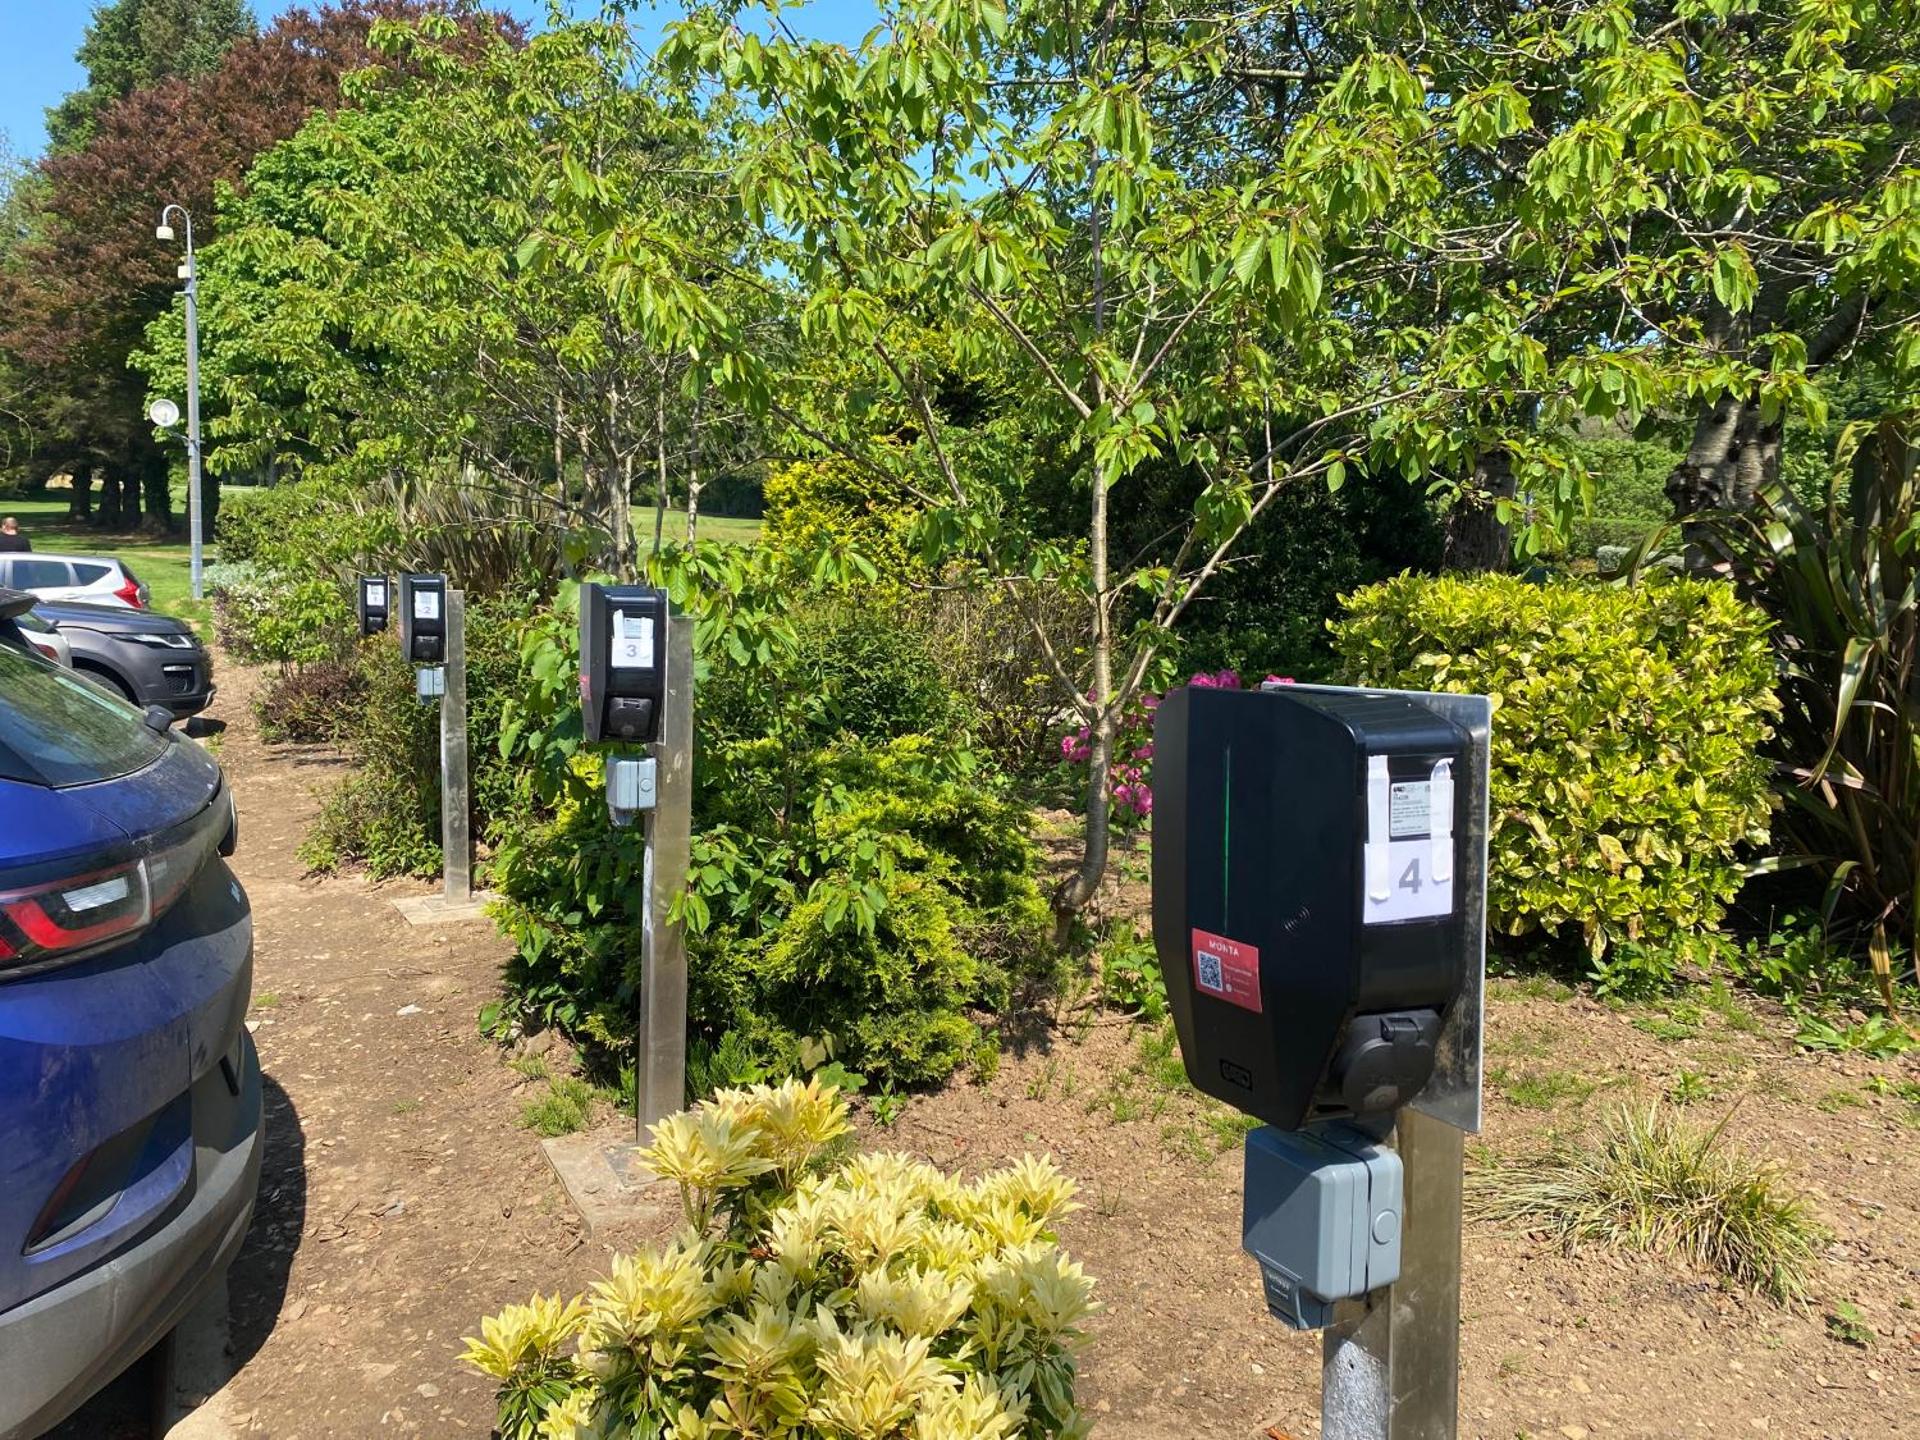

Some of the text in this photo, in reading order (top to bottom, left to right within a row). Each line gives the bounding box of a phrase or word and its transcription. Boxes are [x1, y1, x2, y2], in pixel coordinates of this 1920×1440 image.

[422, 606, 431, 614] 2
[626, 644, 637, 658] 3
[1398, 858, 1423, 895] 4
[1208, 938, 1239, 957] MONTA
